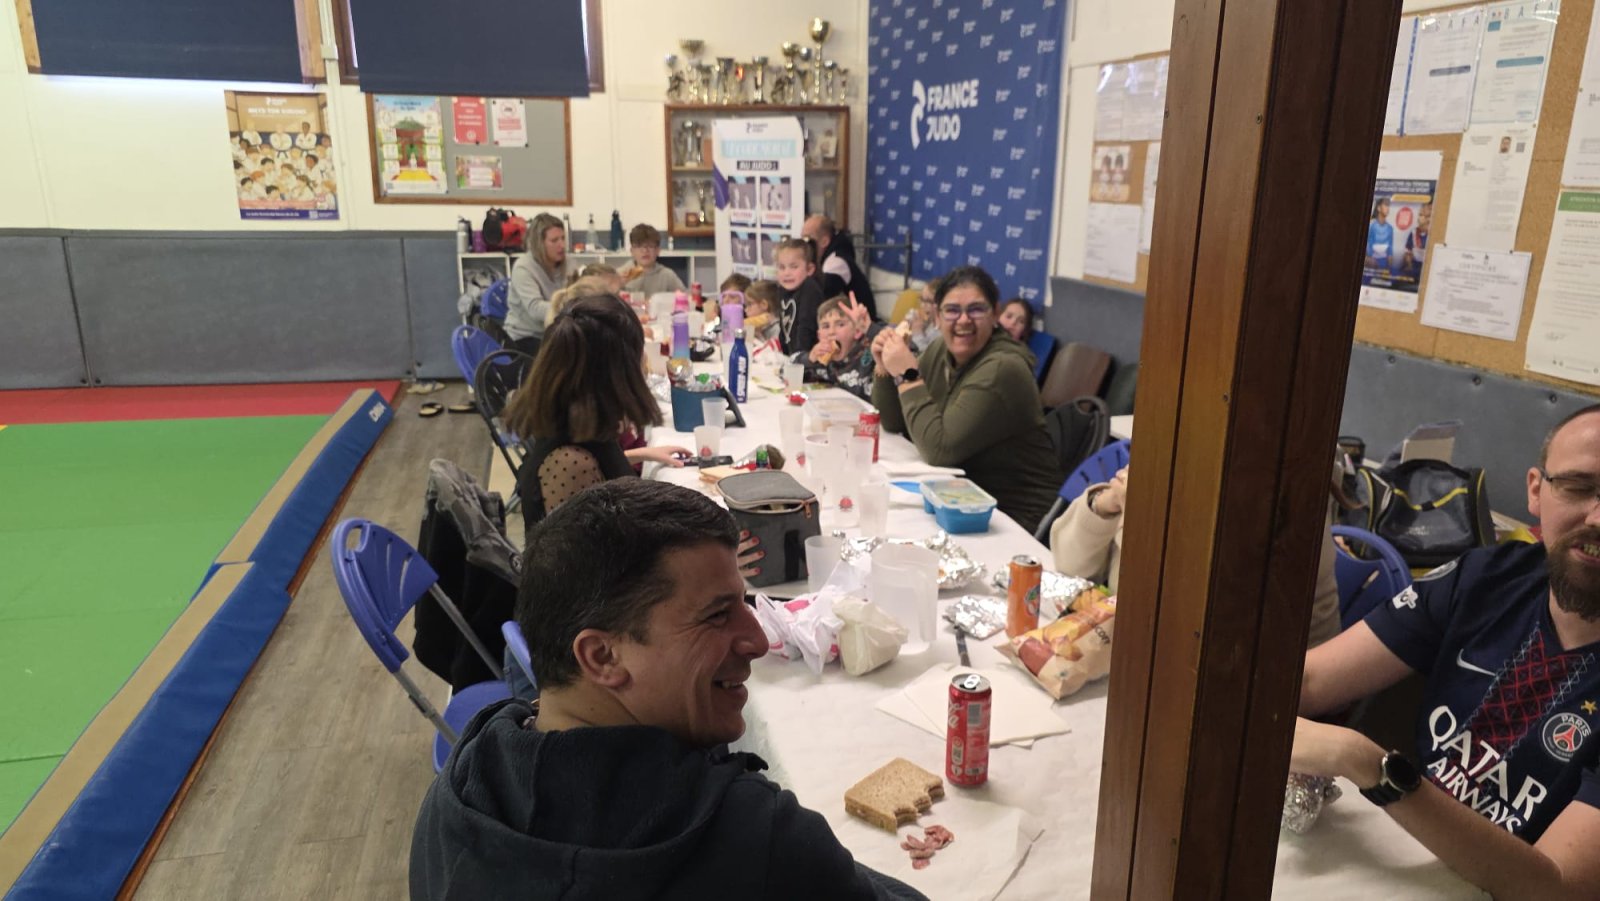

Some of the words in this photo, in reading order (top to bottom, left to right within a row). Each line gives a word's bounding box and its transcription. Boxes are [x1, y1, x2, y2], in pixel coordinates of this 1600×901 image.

[927, 78, 979, 112] FRANCE
[926, 114, 961, 142] JUDO
[1561, 714, 1590, 737] PARIS
[1428, 705, 1548, 822] QATAR
[1426, 756, 1522, 834] AIRWAYS
